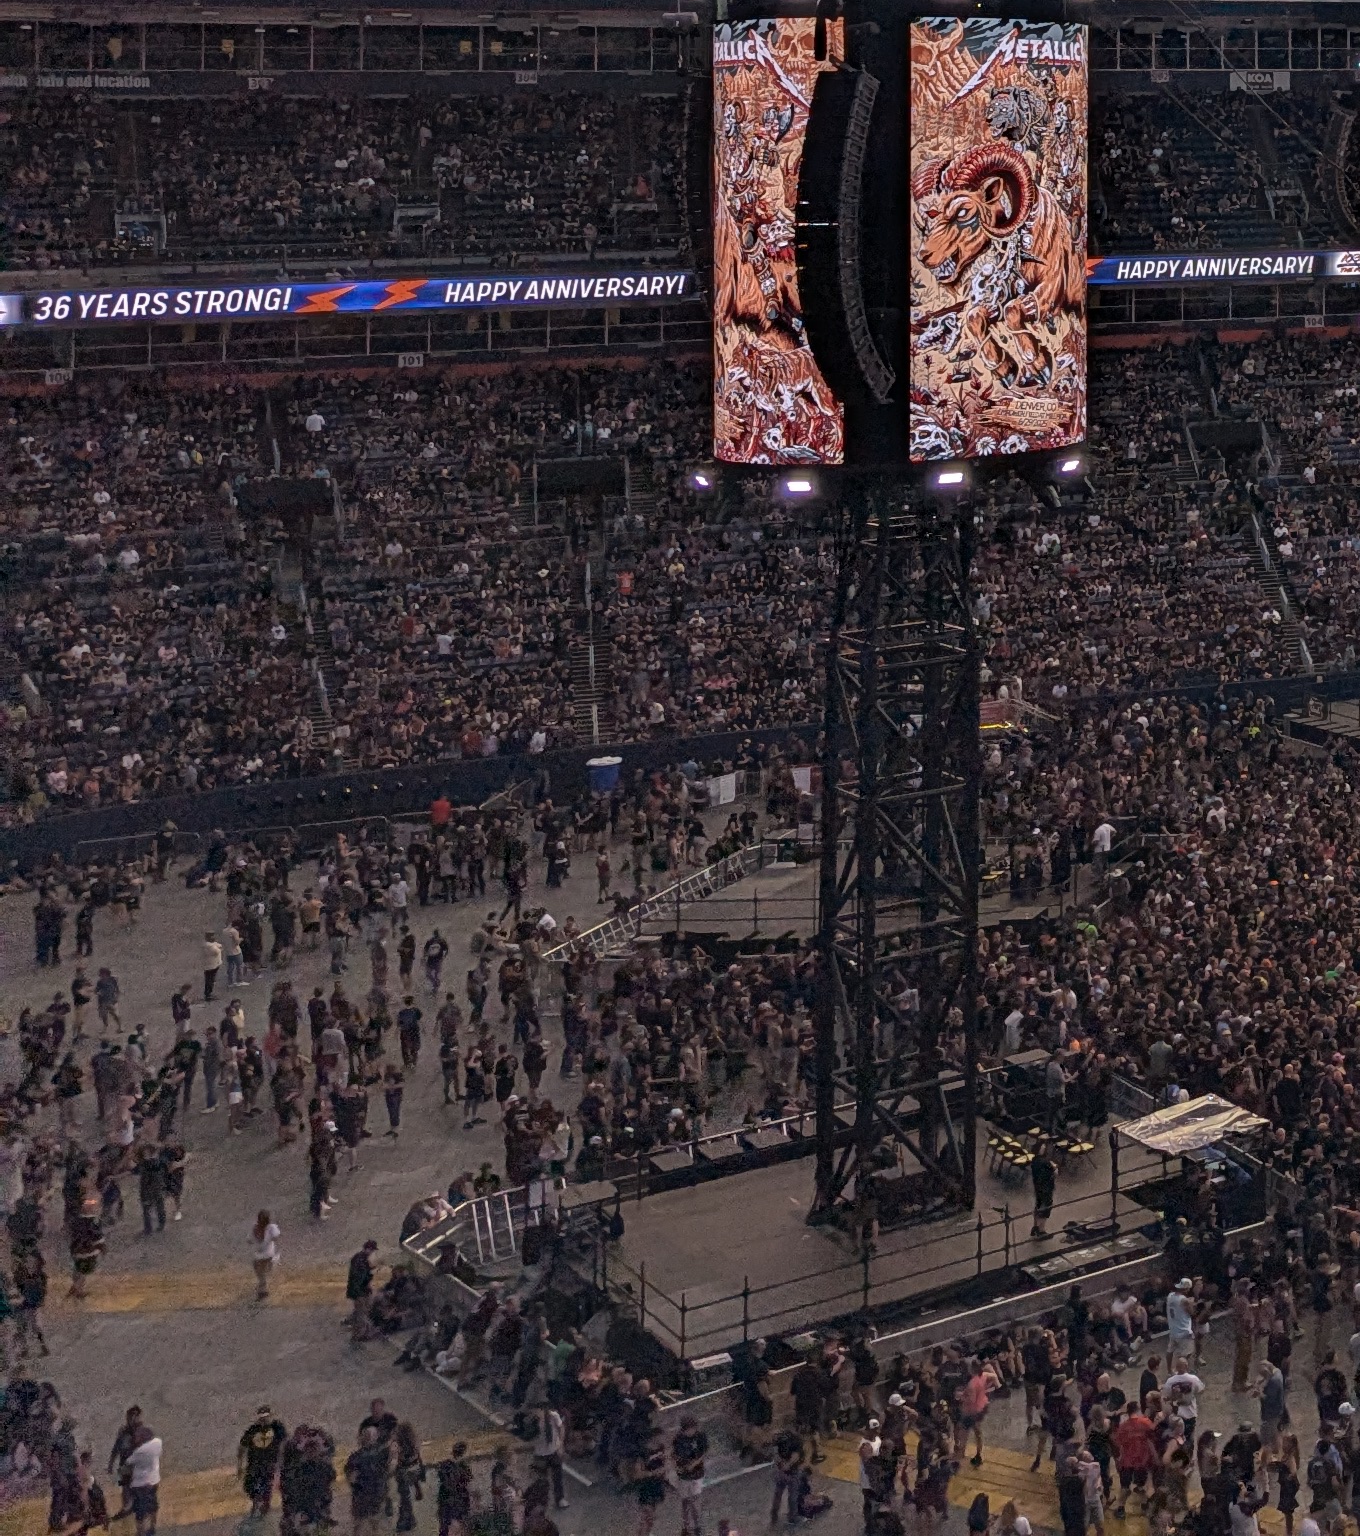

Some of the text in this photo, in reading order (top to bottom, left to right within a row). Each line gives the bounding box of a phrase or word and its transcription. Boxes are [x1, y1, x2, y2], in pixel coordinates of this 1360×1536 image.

[95, 75, 151, 87] location
[1248, 73, 1272, 83] KOA
[1117, 255, 1314, 280] HAPPY ANNIVERSARY!
[445, 275, 686, 303] HAPPY ANNIVERSARY!
[34, 287, 293, 320] 36 YEARS STRONG!
[403, 356, 420, 365] 101
